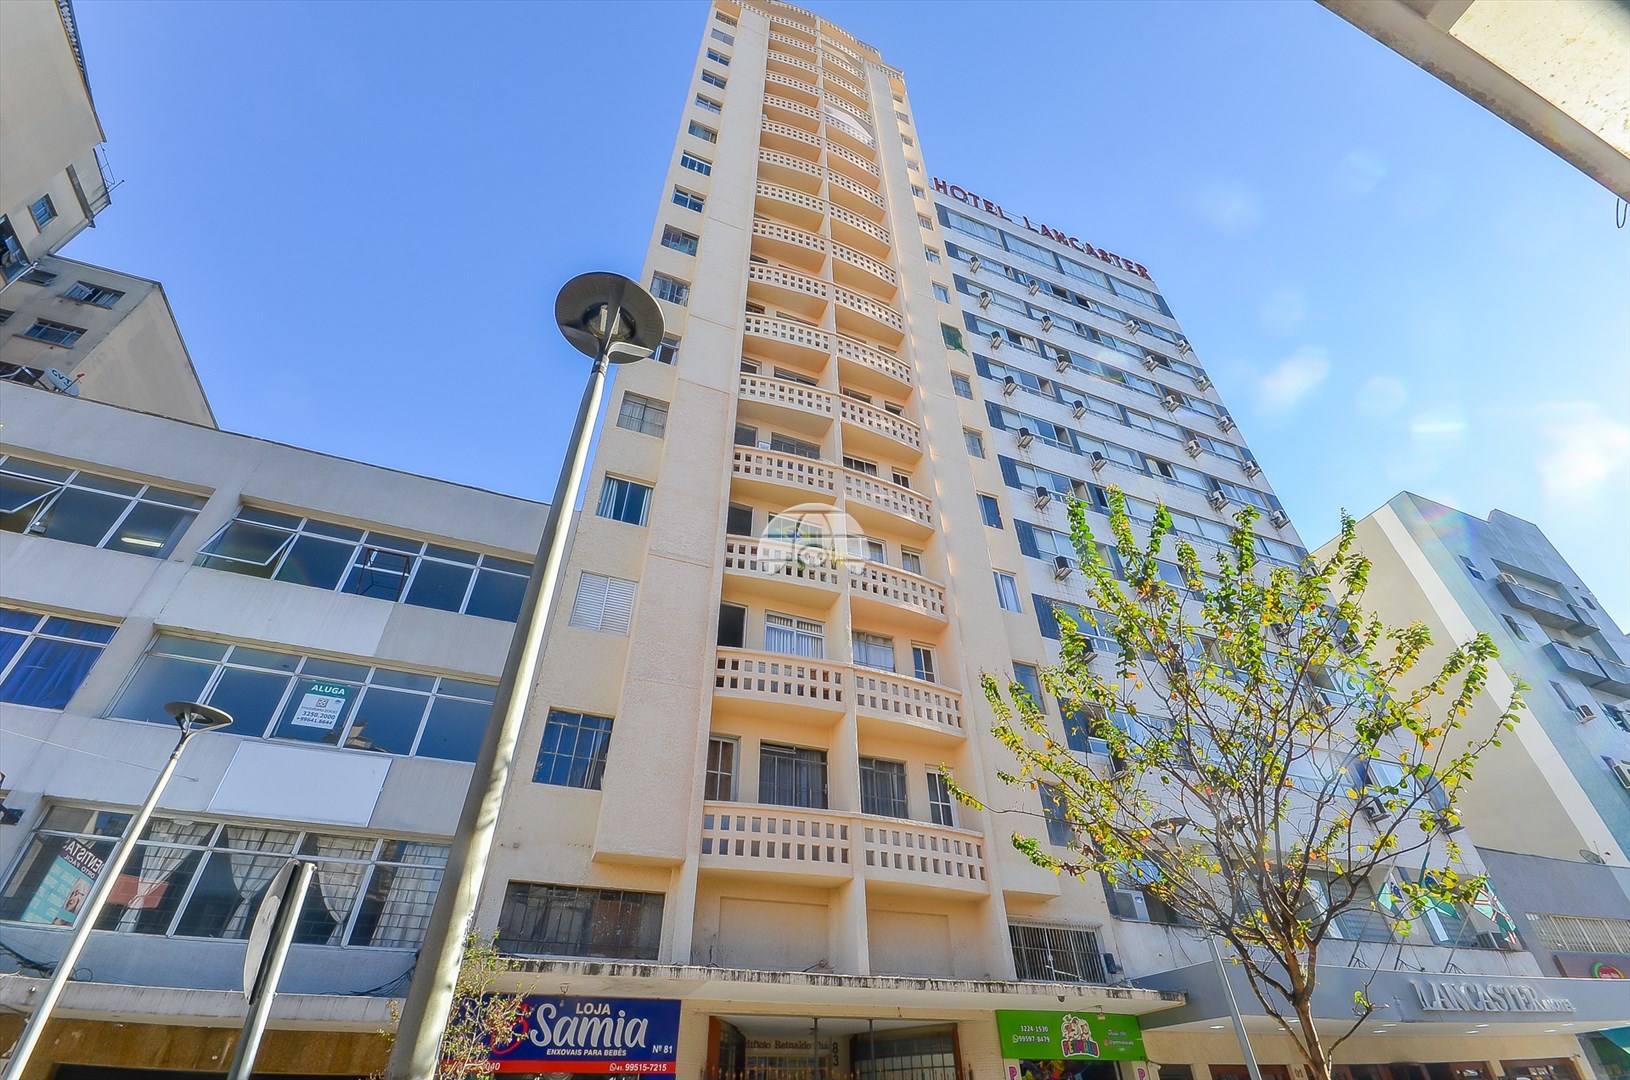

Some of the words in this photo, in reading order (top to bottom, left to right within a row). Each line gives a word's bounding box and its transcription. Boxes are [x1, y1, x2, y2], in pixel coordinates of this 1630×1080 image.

[932, 177, 1012, 222] HOTEL
[1022, 215, 1152, 281] LANCASTER
[311, 684, 345, 695] ALUGA
[1409, 980, 1544, 1012] LANCASTER
[575, 1002, 611, 1015] LOJA
[530, 1003, 649, 1048] Samia
[663, 1045, 673, 1054] 81
[774, 1040, 812, 1049] Reinaldo
[546, 1048, 582, 1056] ENXOVAIS
[625, 1063, 667, 1071] 99515-7215
